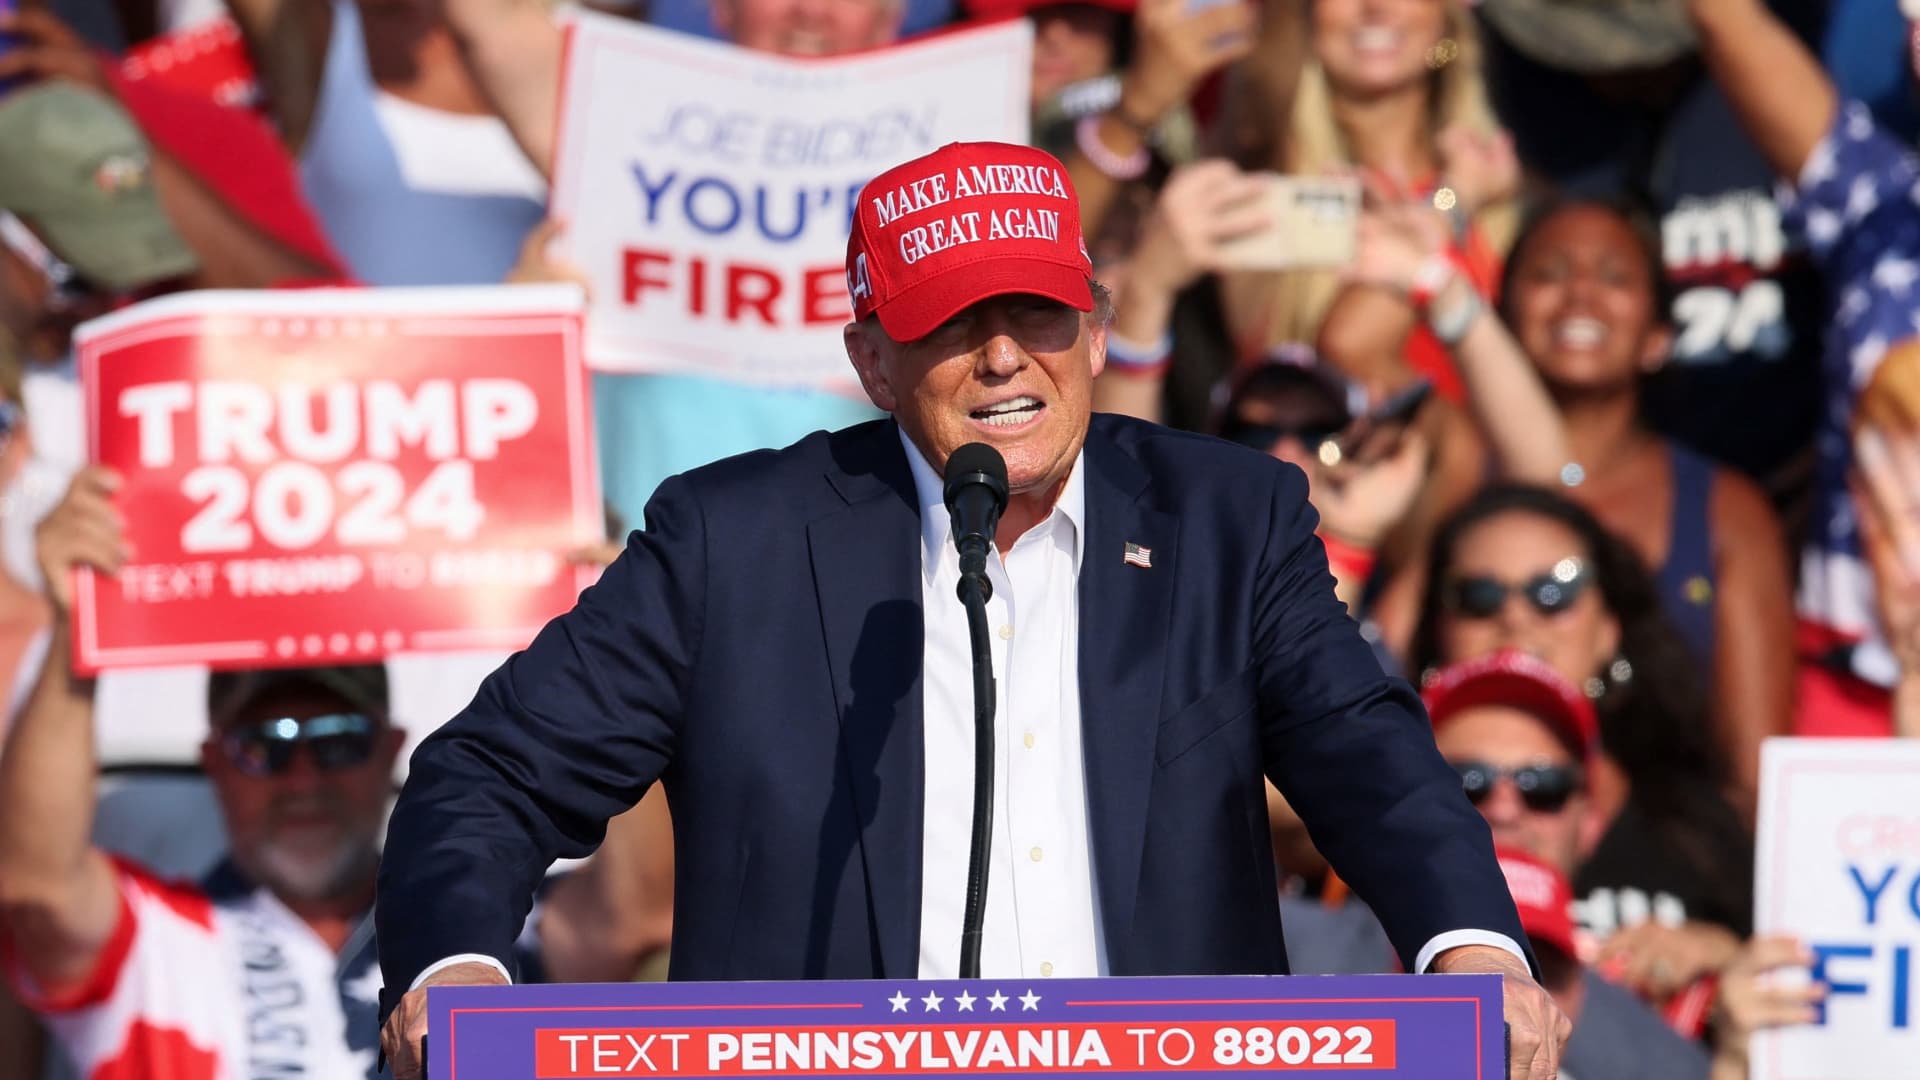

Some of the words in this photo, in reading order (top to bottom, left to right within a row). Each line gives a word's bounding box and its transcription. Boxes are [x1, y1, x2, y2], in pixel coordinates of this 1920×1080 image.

[873, 173, 950, 228] MAKE
[954, 165, 1069, 200] AMERICA
[900, 211, 981, 265] GREAT
[988, 208, 1060, 243] AGAIN
[118, 377, 539, 468] TRUMP
[179, 459, 486, 552] 2024
[120, 563, 214, 603] TEXT
[559, 1034, 690, 1072] TEXT
[708, 1029, 1112, 1070] PENNSYLVANIA
[1126, 1028, 1195, 1066] TO
[1213, 1026, 1373, 1065] 88022
